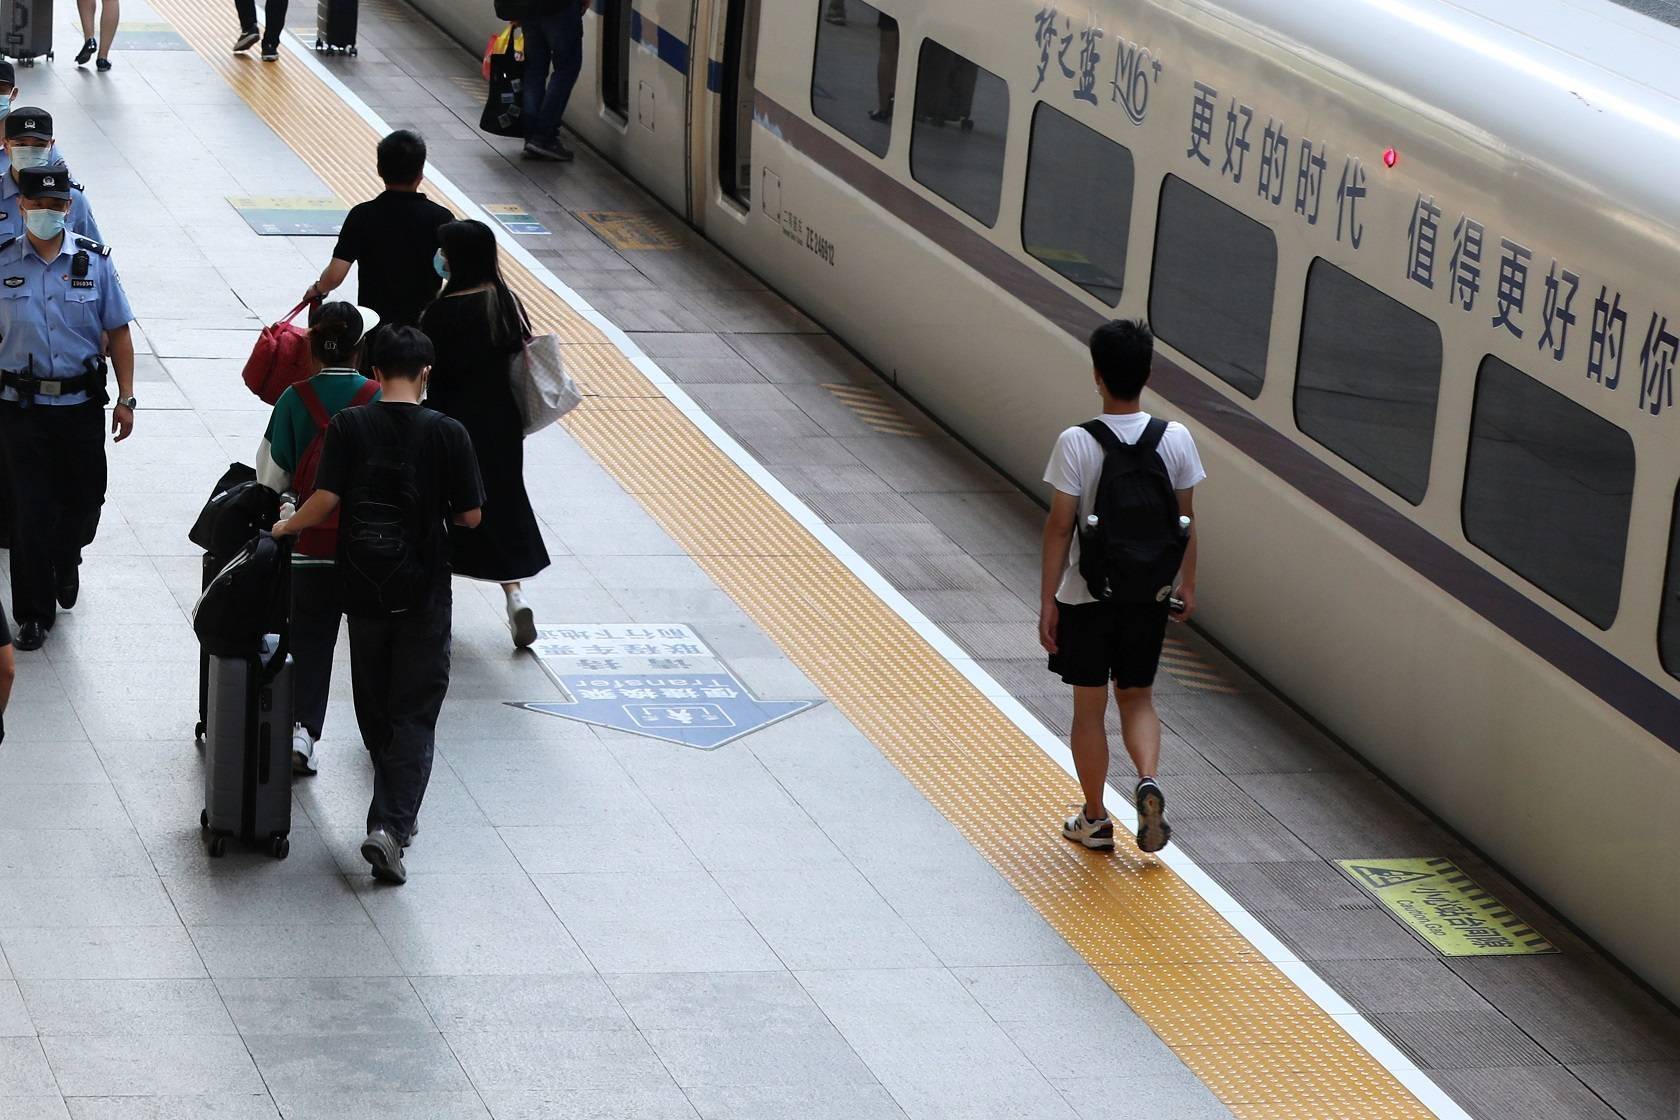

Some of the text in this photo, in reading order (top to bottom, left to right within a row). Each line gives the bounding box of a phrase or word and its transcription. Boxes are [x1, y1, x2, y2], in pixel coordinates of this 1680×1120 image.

[1031, 4, 1101, 106] 梦之蓝
[1186, 80, 1367, 249] 更好的时代
[1406, 193, 1679, 416] 值得更好的你
[576, 679, 729, 688] Transfer
[1396, 899, 1428, 924] Caution
